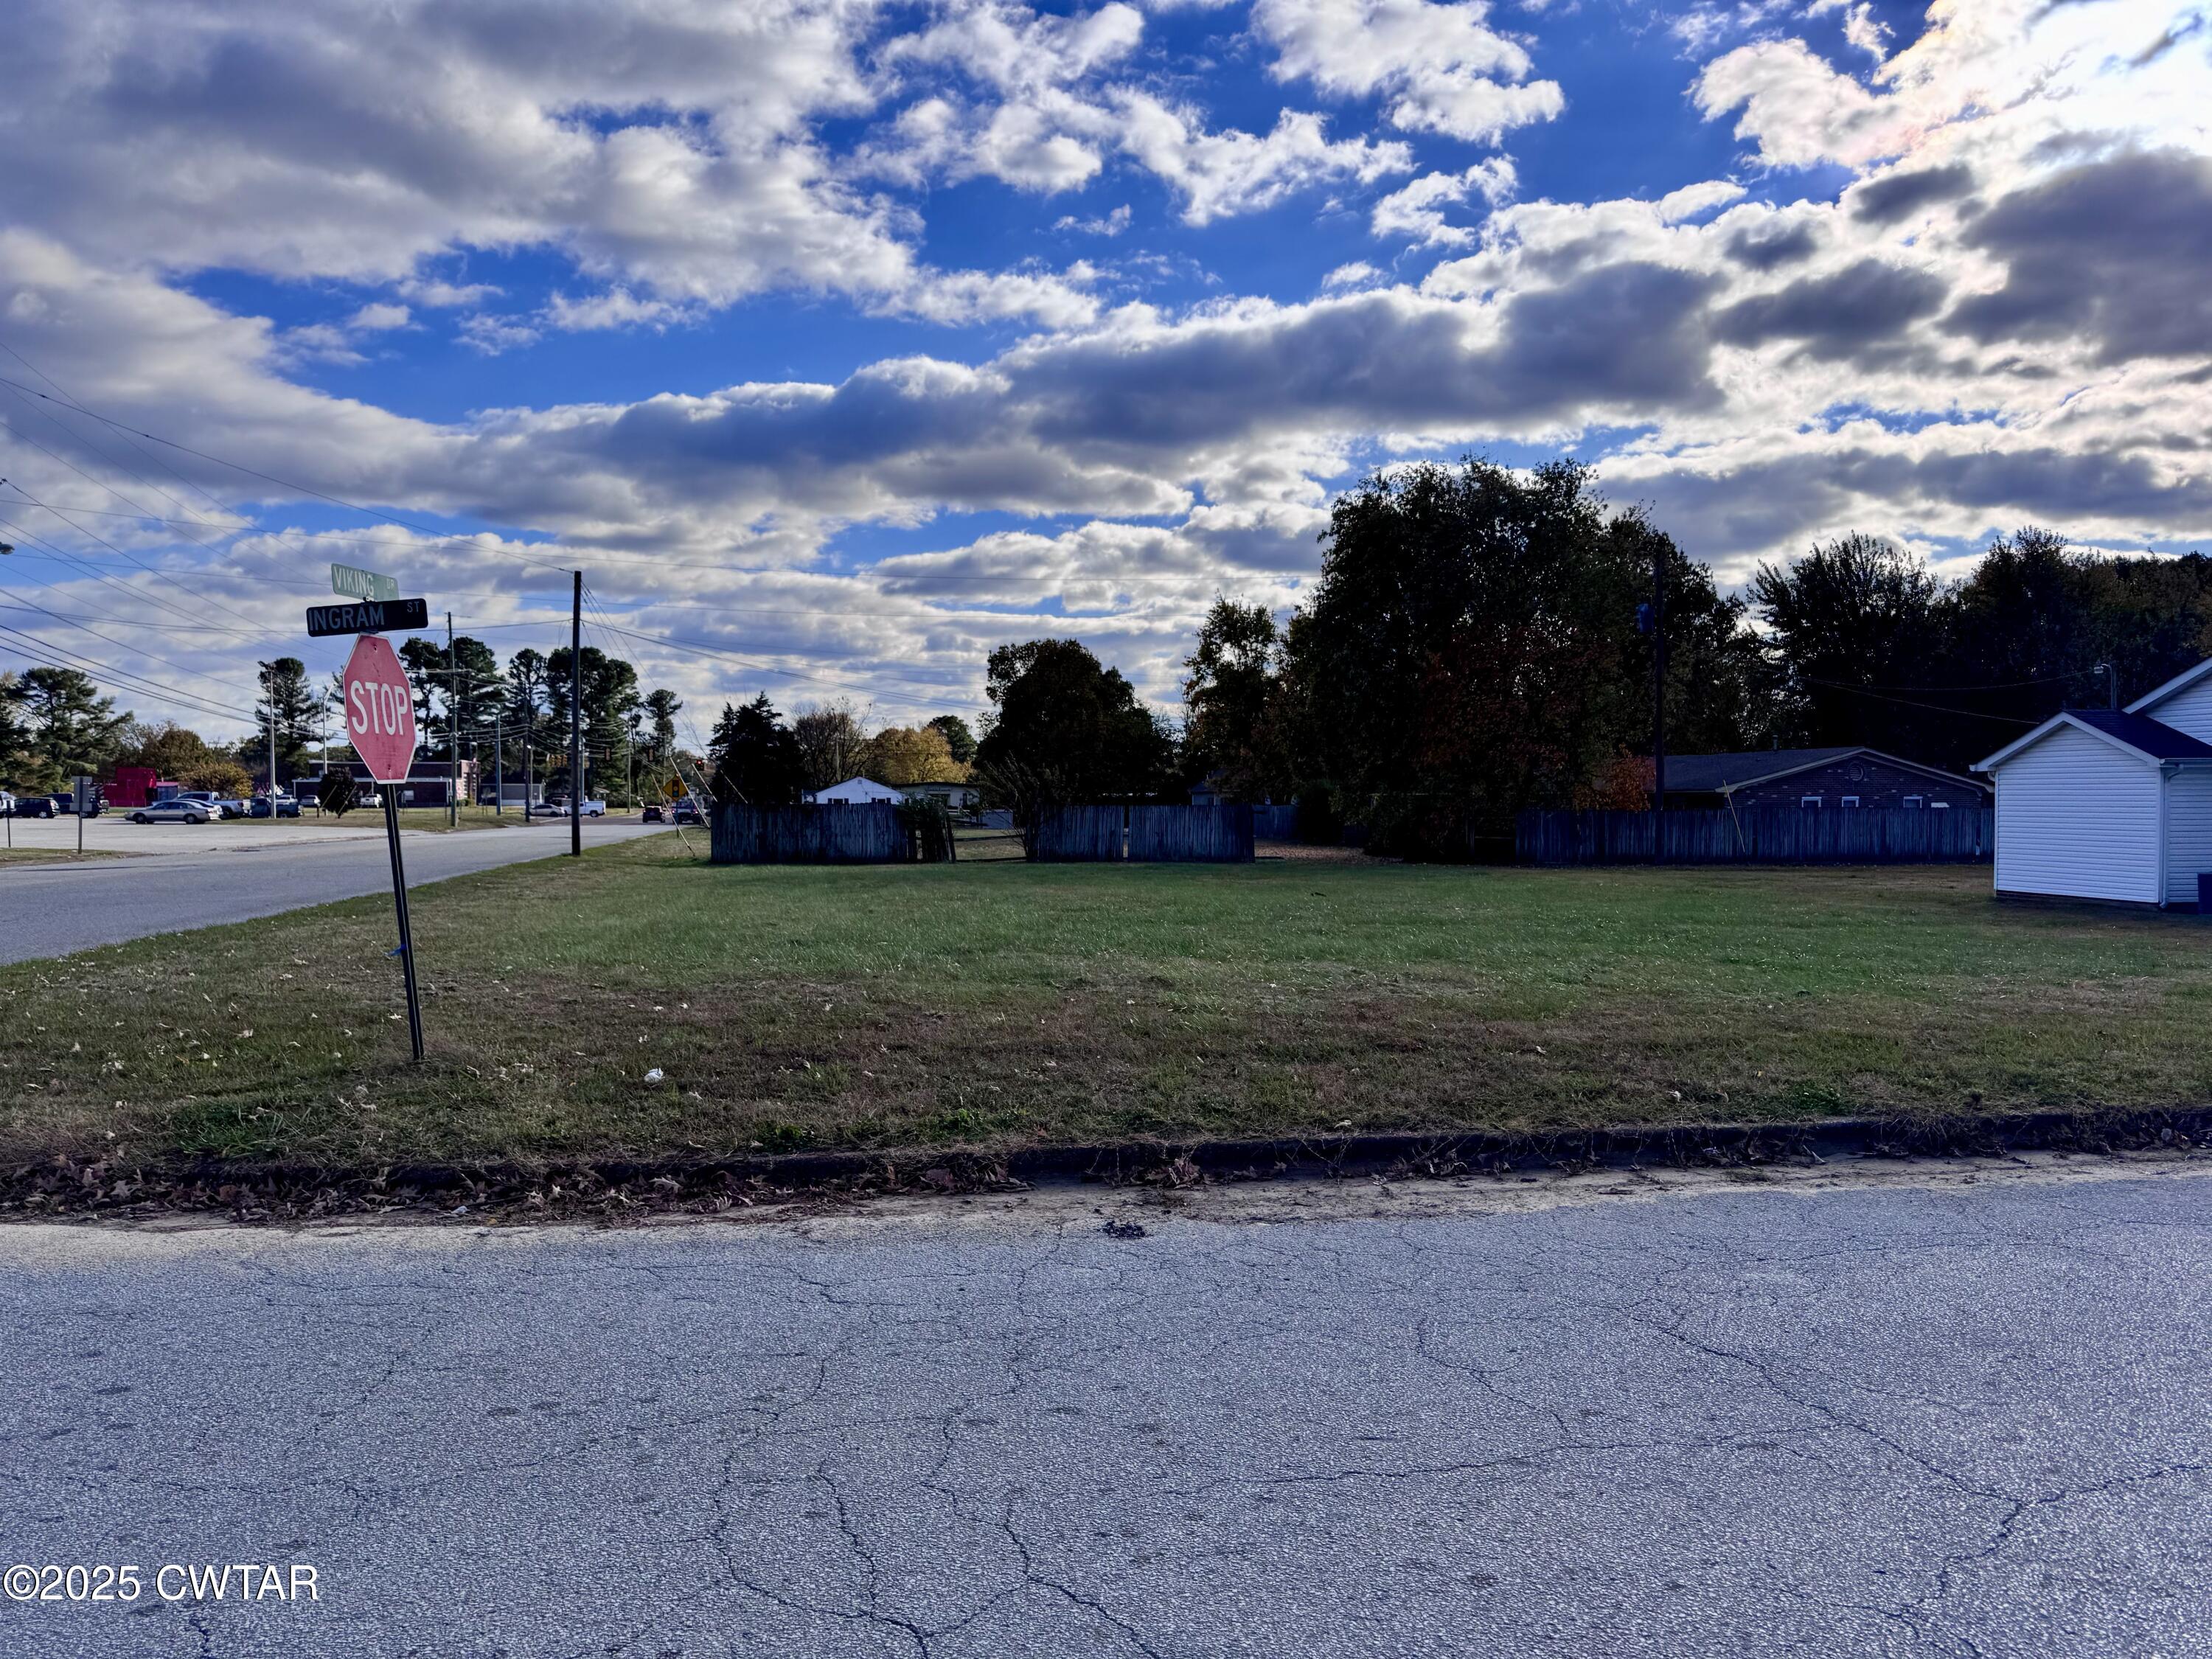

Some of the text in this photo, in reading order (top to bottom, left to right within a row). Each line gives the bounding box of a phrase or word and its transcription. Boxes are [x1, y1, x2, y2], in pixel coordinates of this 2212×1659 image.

[333, 566, 394, 596] VIKING DR
[308, 601, 419, 630] INGRAM ST
[350, 680, 407, 735] STOP
